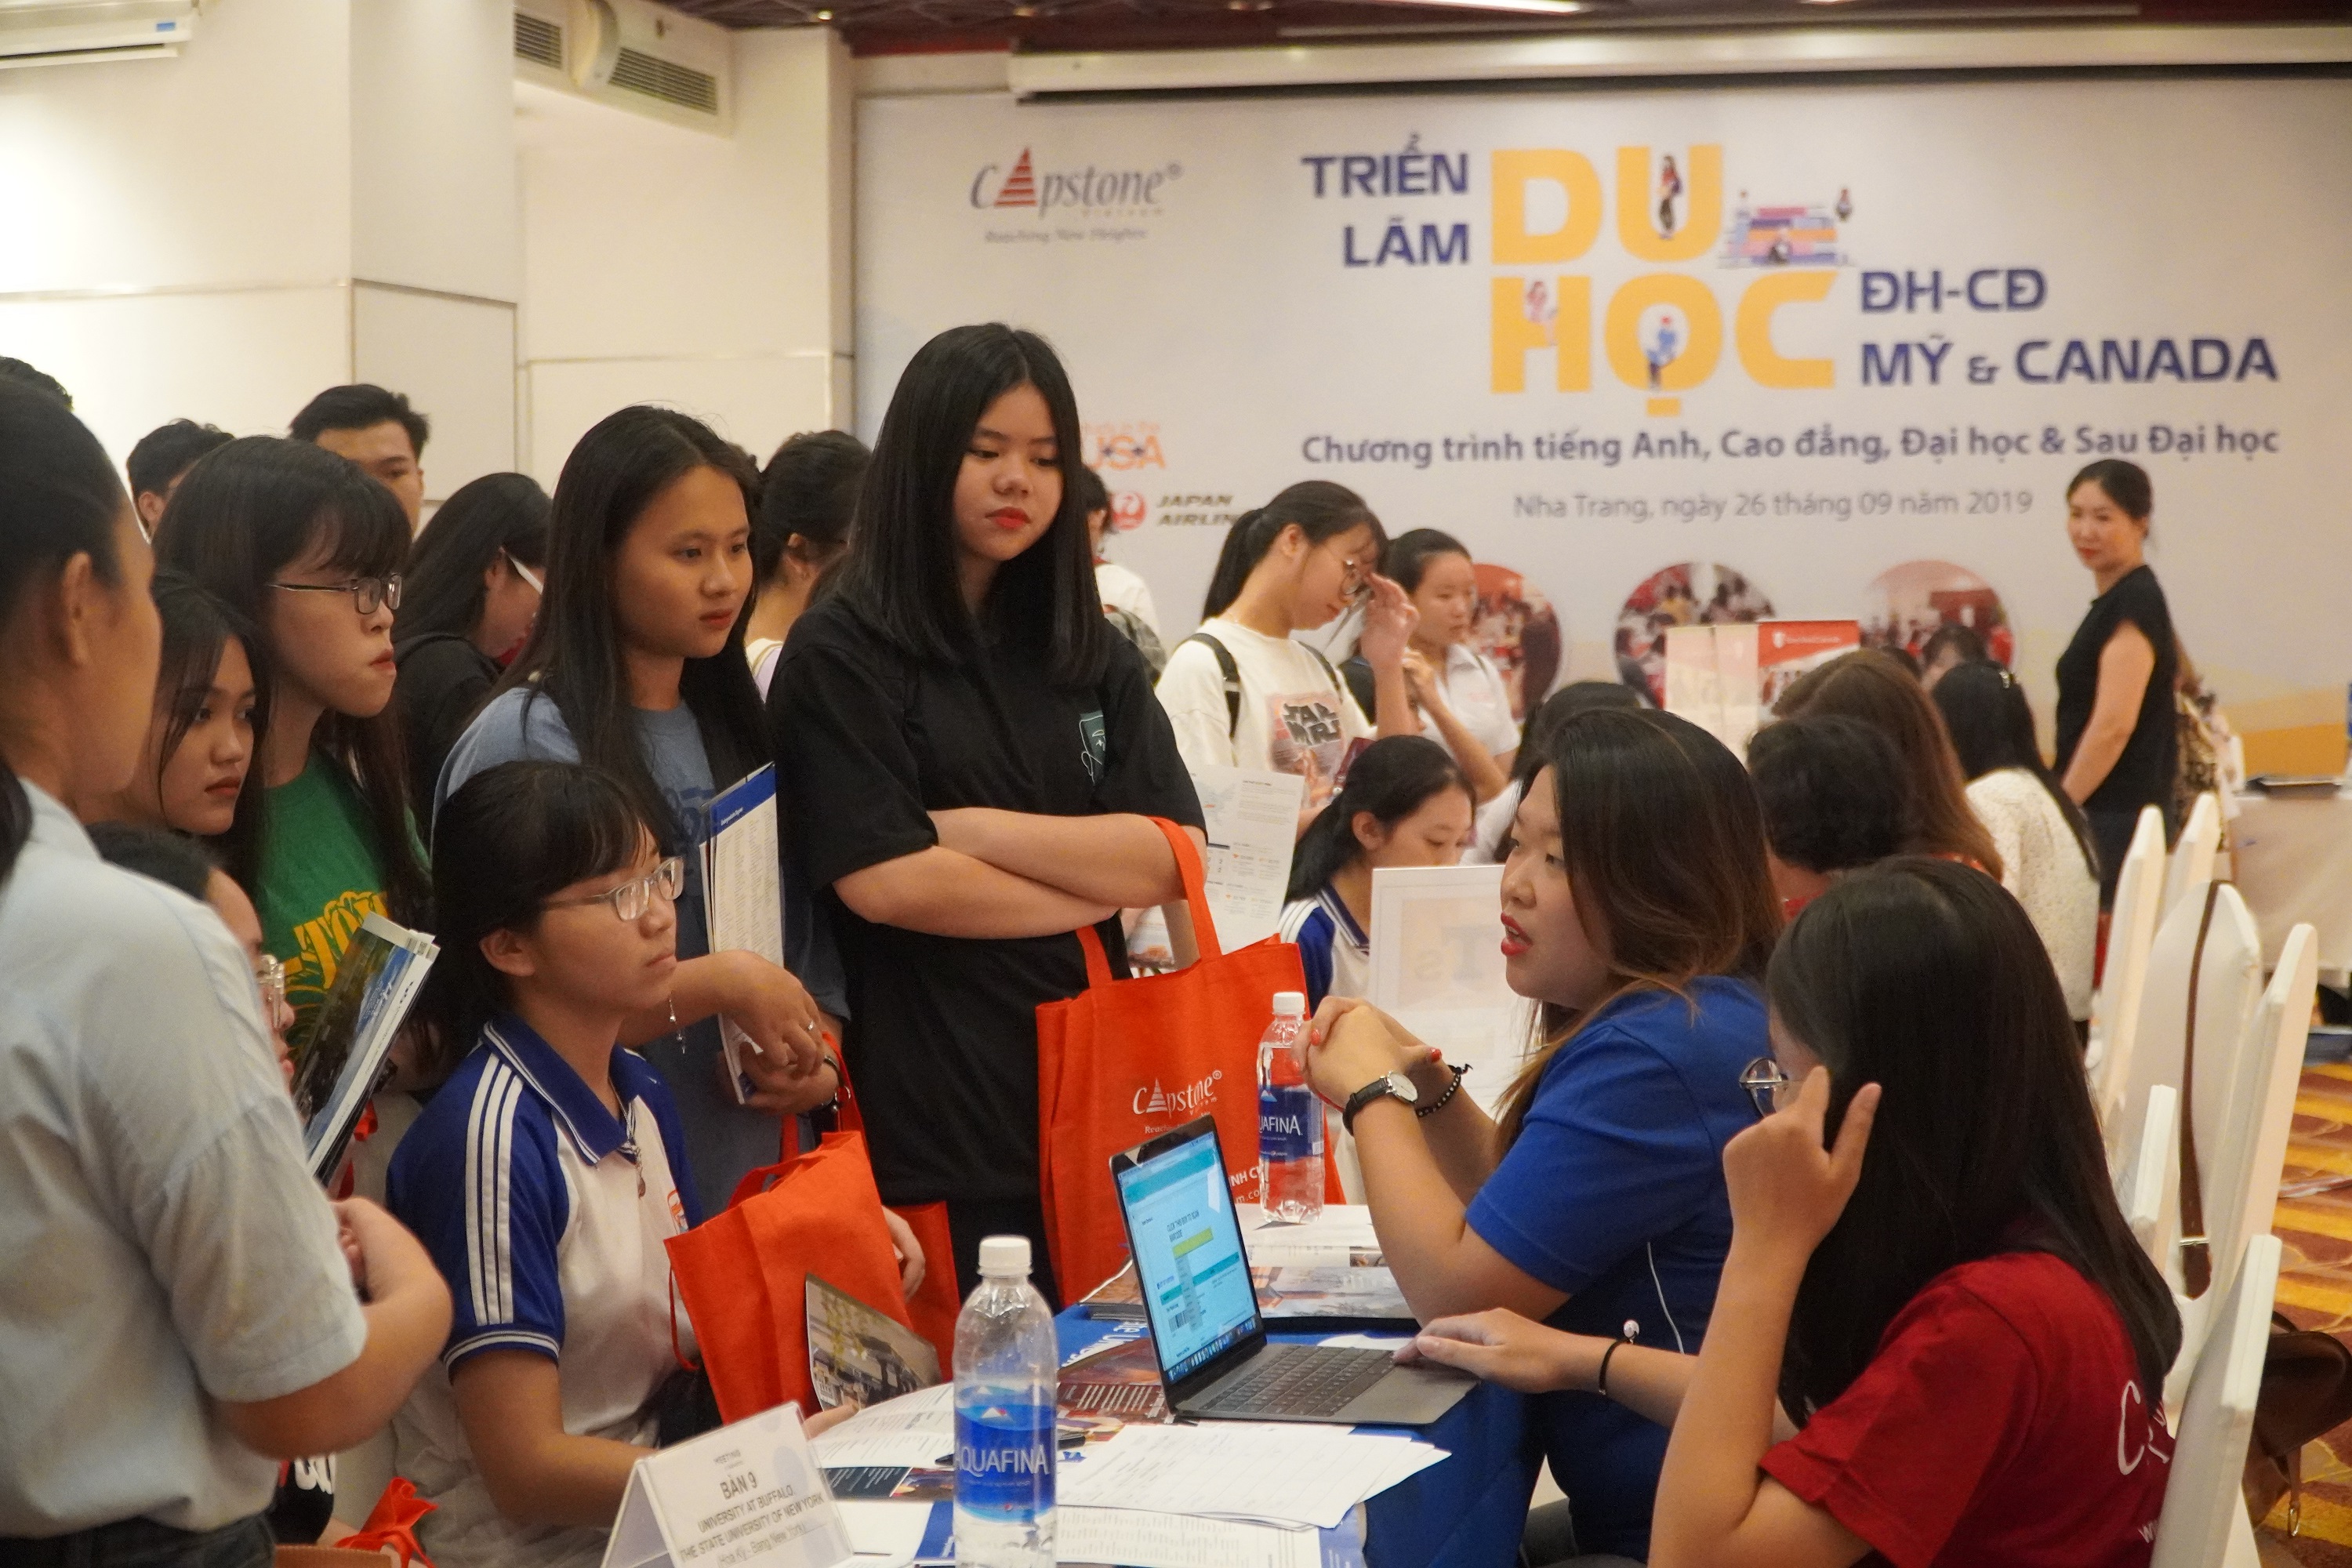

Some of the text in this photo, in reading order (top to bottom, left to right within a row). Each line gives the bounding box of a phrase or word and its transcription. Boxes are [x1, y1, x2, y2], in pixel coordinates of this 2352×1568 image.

[1301, 132, 1468, 198] TRIỂN
[1491, 144, 1723, 266] DU
[1343, 213, 1468, 268] LÃM
[1860, 268, 2048, 313] ĐH-CĐ
[1491, 270, 1839, 418] HỌC
[1861, 332, 2280, 387] MỸ & CANADA
[1301, 423, 2279, 470] Chương trình tiếng Anh, Cao đẳng, Đại học & Sau Đại học
[1157, 514, 1240, 527] AIRLIN
[1159, 495, 1234, 509] JAPAN
[1513, 488, 2034, 524] Nha Trang, ngày 26 tháng 09 năm 2019
[748, 1471, 759, 1490] 9
[698, 1505, 746, 1534] UNIVERSITY
[746, 1499, 757, 1512] AT
[698, 1534, 725, 1555] STATE
[725, 1513, 771, 1544] UNIVERSITY
[771, 1508, 783, 1523] OF
[783, 1501, 803, 1519] NEW
[801, 1492, 825, 1511] YORK
